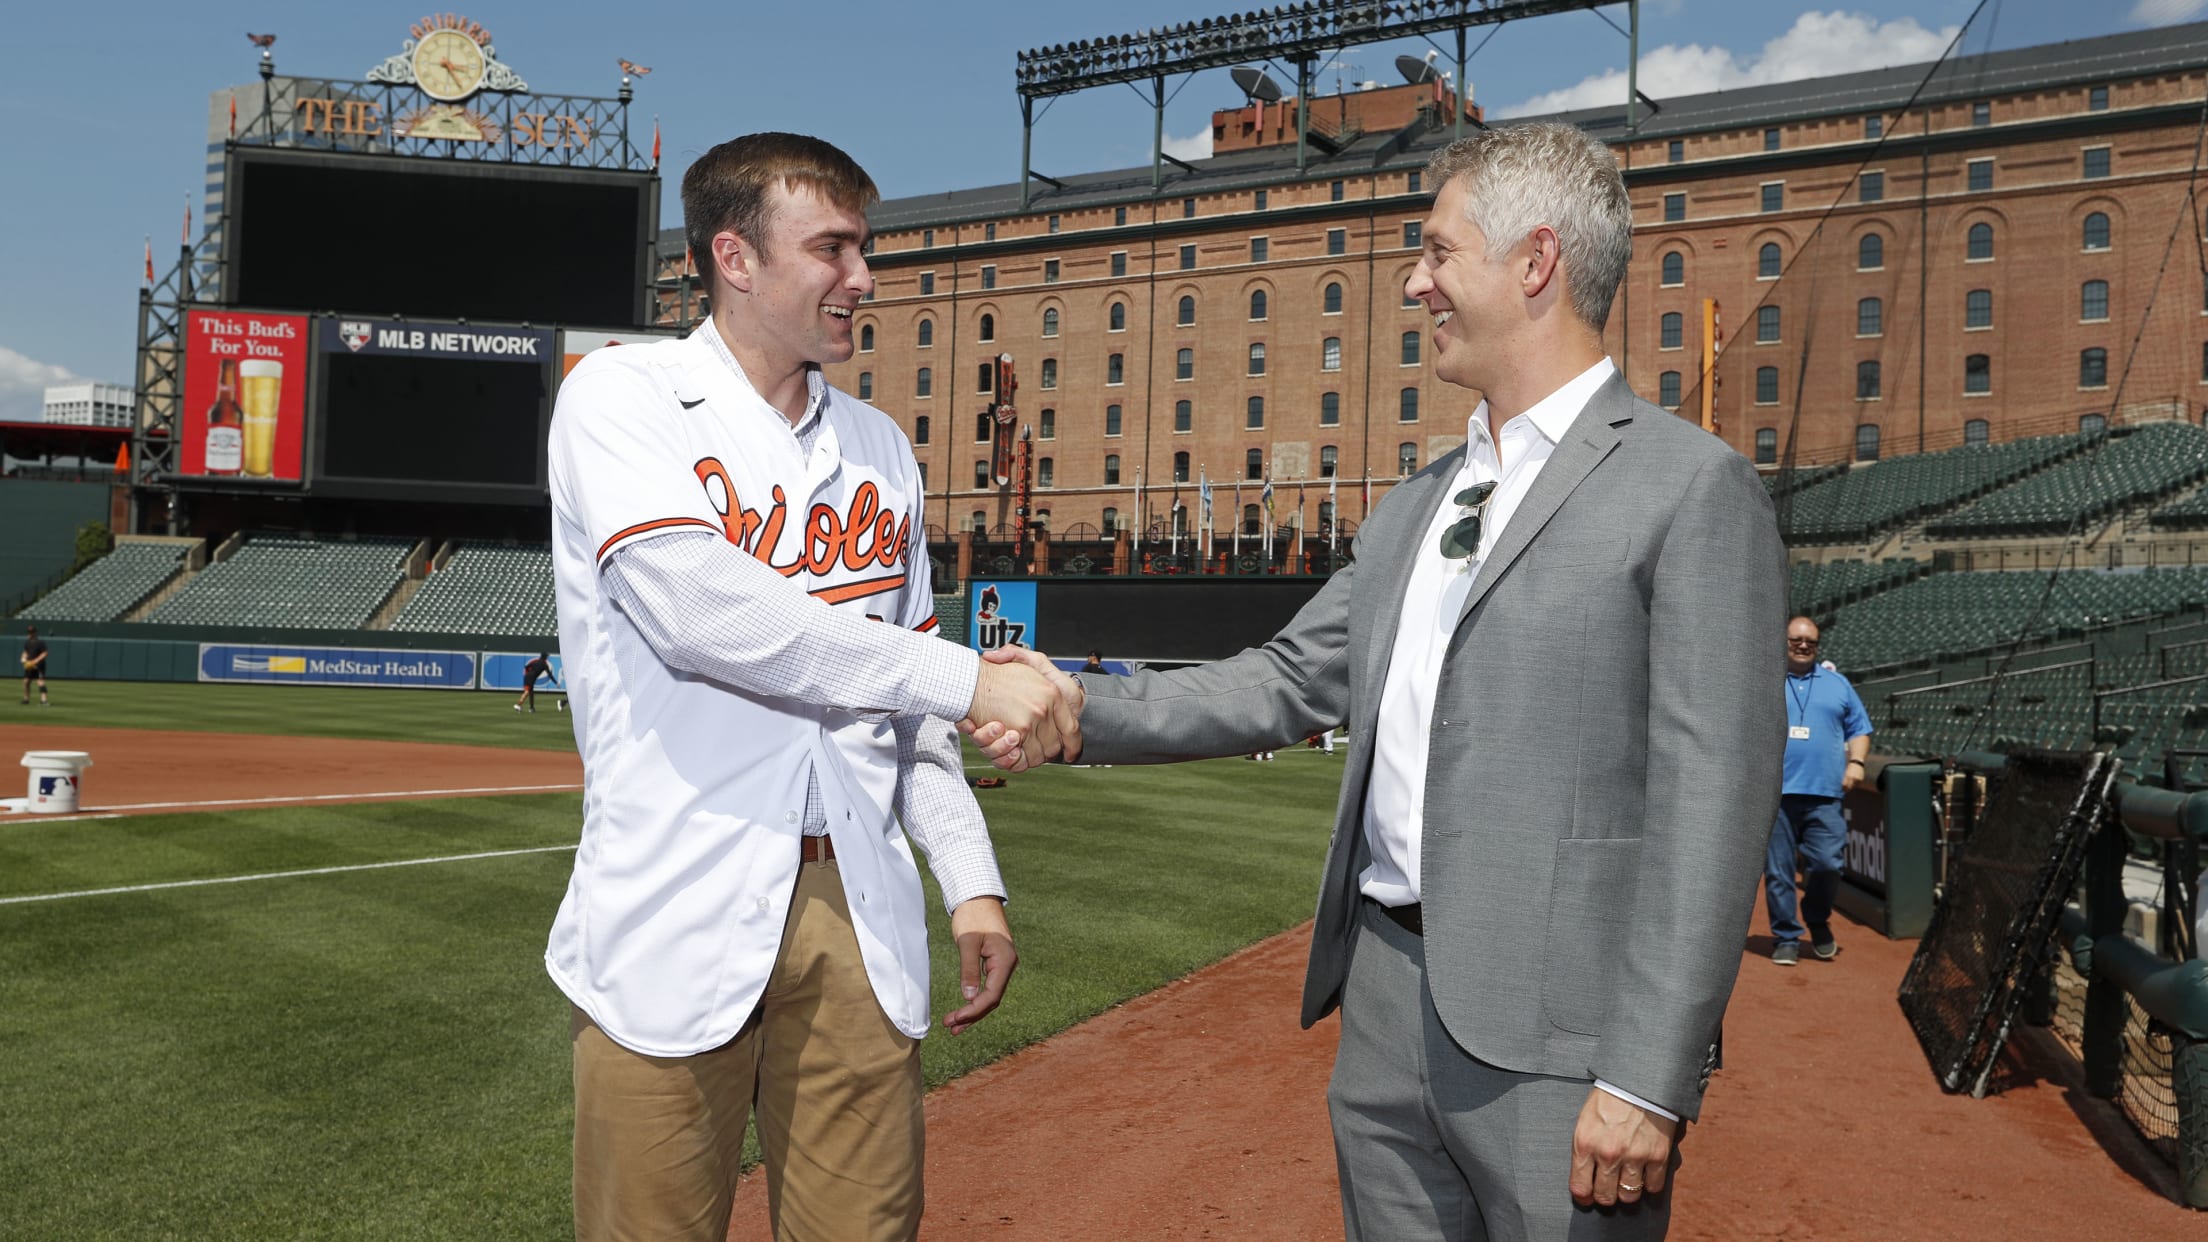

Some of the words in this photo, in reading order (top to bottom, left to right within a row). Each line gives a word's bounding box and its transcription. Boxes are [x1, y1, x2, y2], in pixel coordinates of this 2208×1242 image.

[409, 12, 492, 46] ORIOLES
[296, 97, 383, 136] THE
[512, 111, 594, 148] SUN
[199, 317, 243, 335] This
[210, 337, 241, 354] For
[244, 339, 283, 357] You.
[378, 329, 425, 350] MLB
[430, 332, 537, 355] NETWORK
[309, 659, 381, 676] MedStar
[385, 661, 443, 677] Health
[1844, 820, 1885, 884] anati
